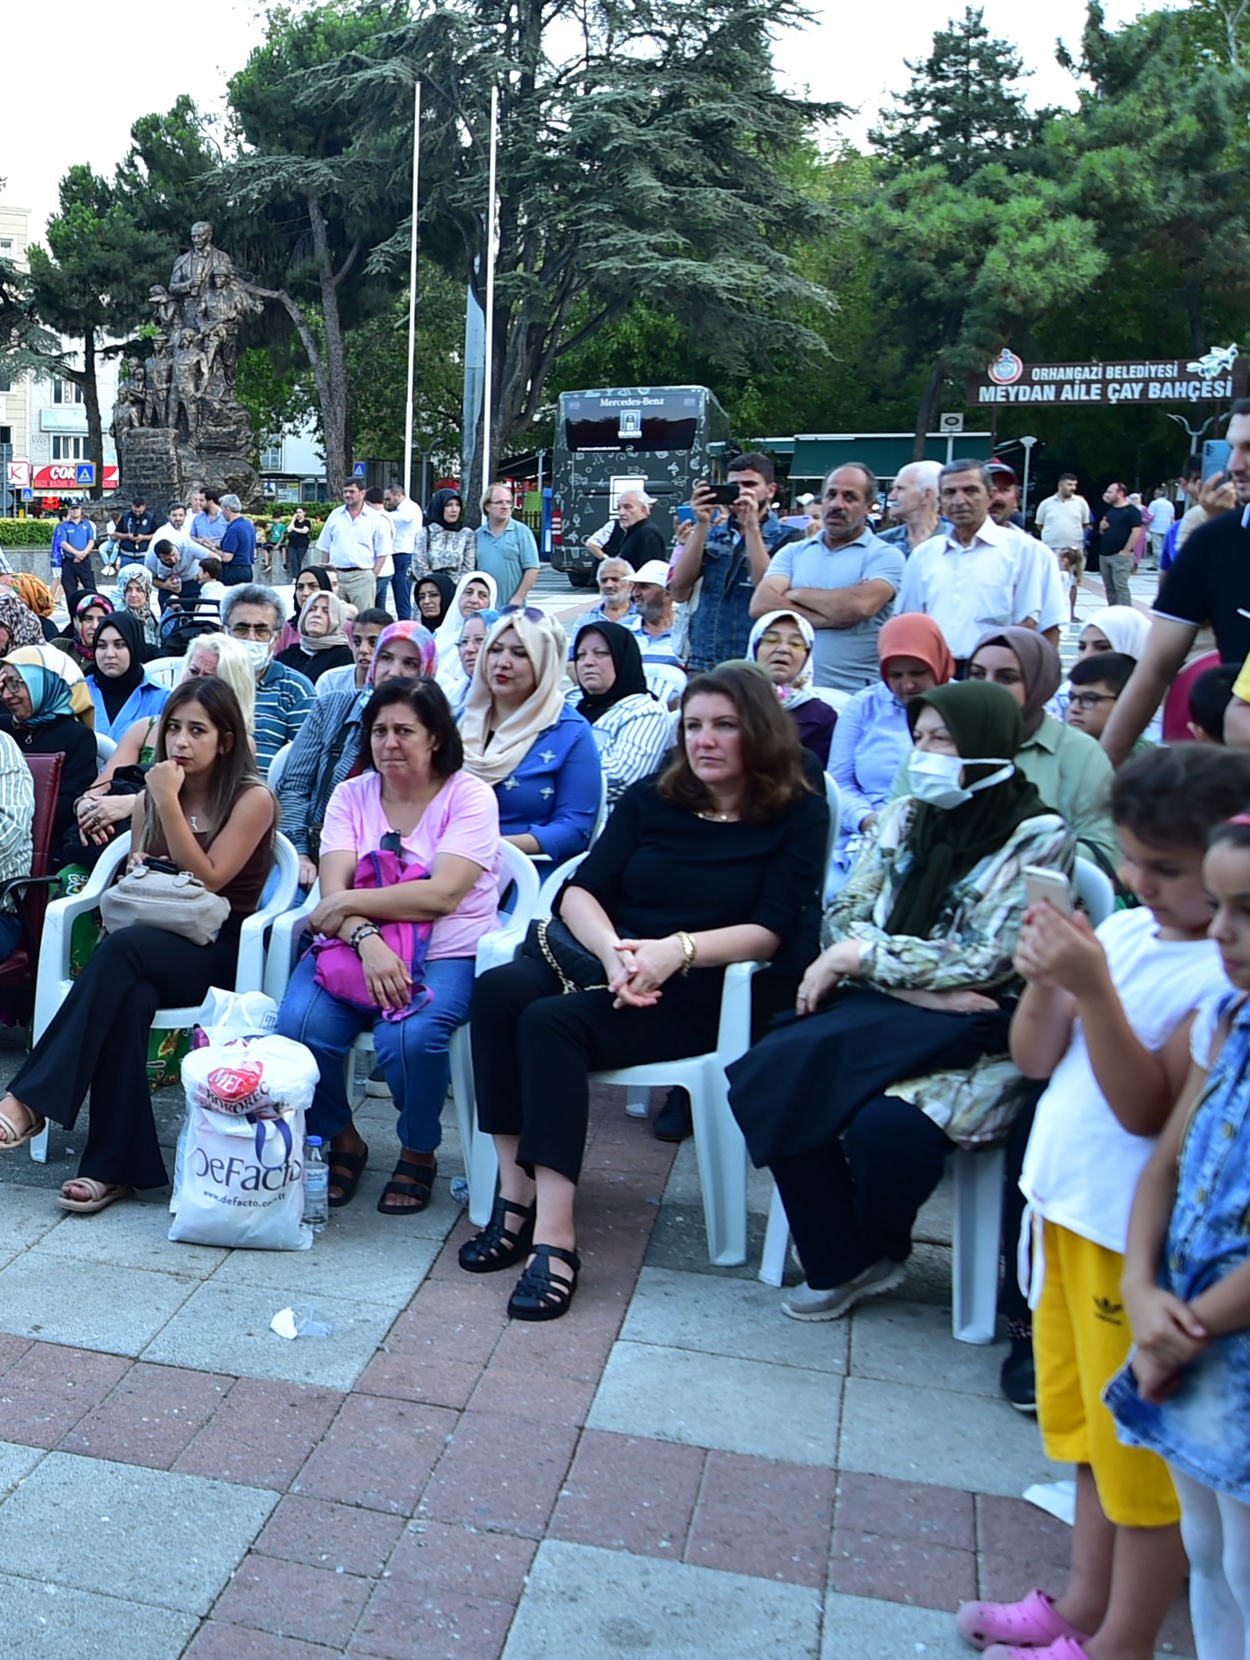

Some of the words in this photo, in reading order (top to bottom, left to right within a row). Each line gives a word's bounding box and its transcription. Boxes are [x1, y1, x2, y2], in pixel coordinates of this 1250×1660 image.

[1031, 363, 1103, 381] ORHANGAZİ
[1105, 361, 1178, 379] BELEDİYESİ
[978, 385, 1055, 402] MEYDAN
[1060, 380, 1101, 401] AİLE
[1107, 382, 1144, 404] ÇAY
[1148, 375, 1232, 402] BAHÇESİ
[599, 397, 665, 407] Mercedes-Benz
